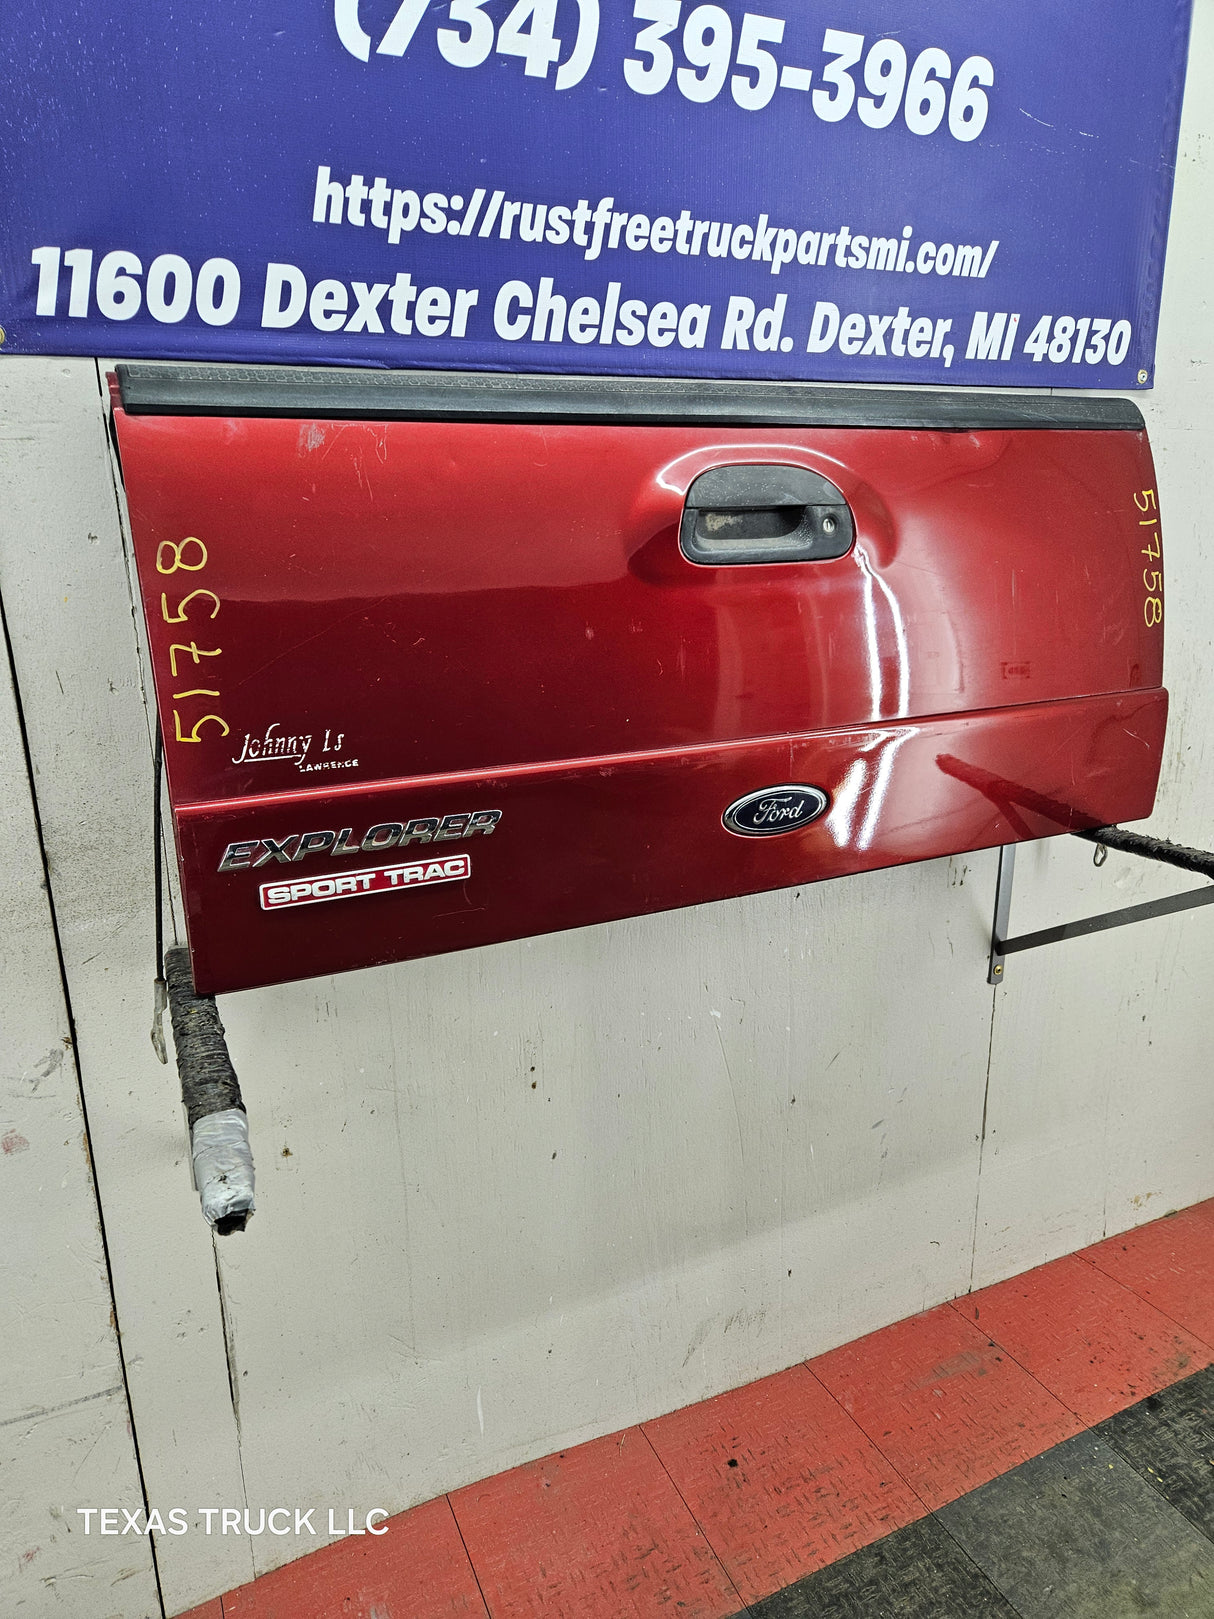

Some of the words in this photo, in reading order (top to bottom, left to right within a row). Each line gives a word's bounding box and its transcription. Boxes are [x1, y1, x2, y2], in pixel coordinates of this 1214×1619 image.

[623, 0, 994, 142] 395-3966
[312, 165, 999, 279] https://rustfreetruckpartsmi.com/
[31, 246, 241, 326] 11600
[261, 263, 478, 339] Dexter
[494, 277, 711, 348] Chelsea
[720, 293, 794, 353] Rd.
[807, 301, 954, 368] Dexter,
[965, 311, 1021, 361] MI
[1023, 315, 1132, 366] 48130
[1133, 489, 1163, 628] 51758
[156, 536, 230, 743] 51758
[232, 723, 312, 765] Johnny
[298, 758, 359, 773] LAWRENCE
[217, 809, 503, 872] EXPLORER
[753, 797, 805, 824] Ford
[267, 873, 376, 905] SPORT
[387, 859, 466, 885] TRAC
